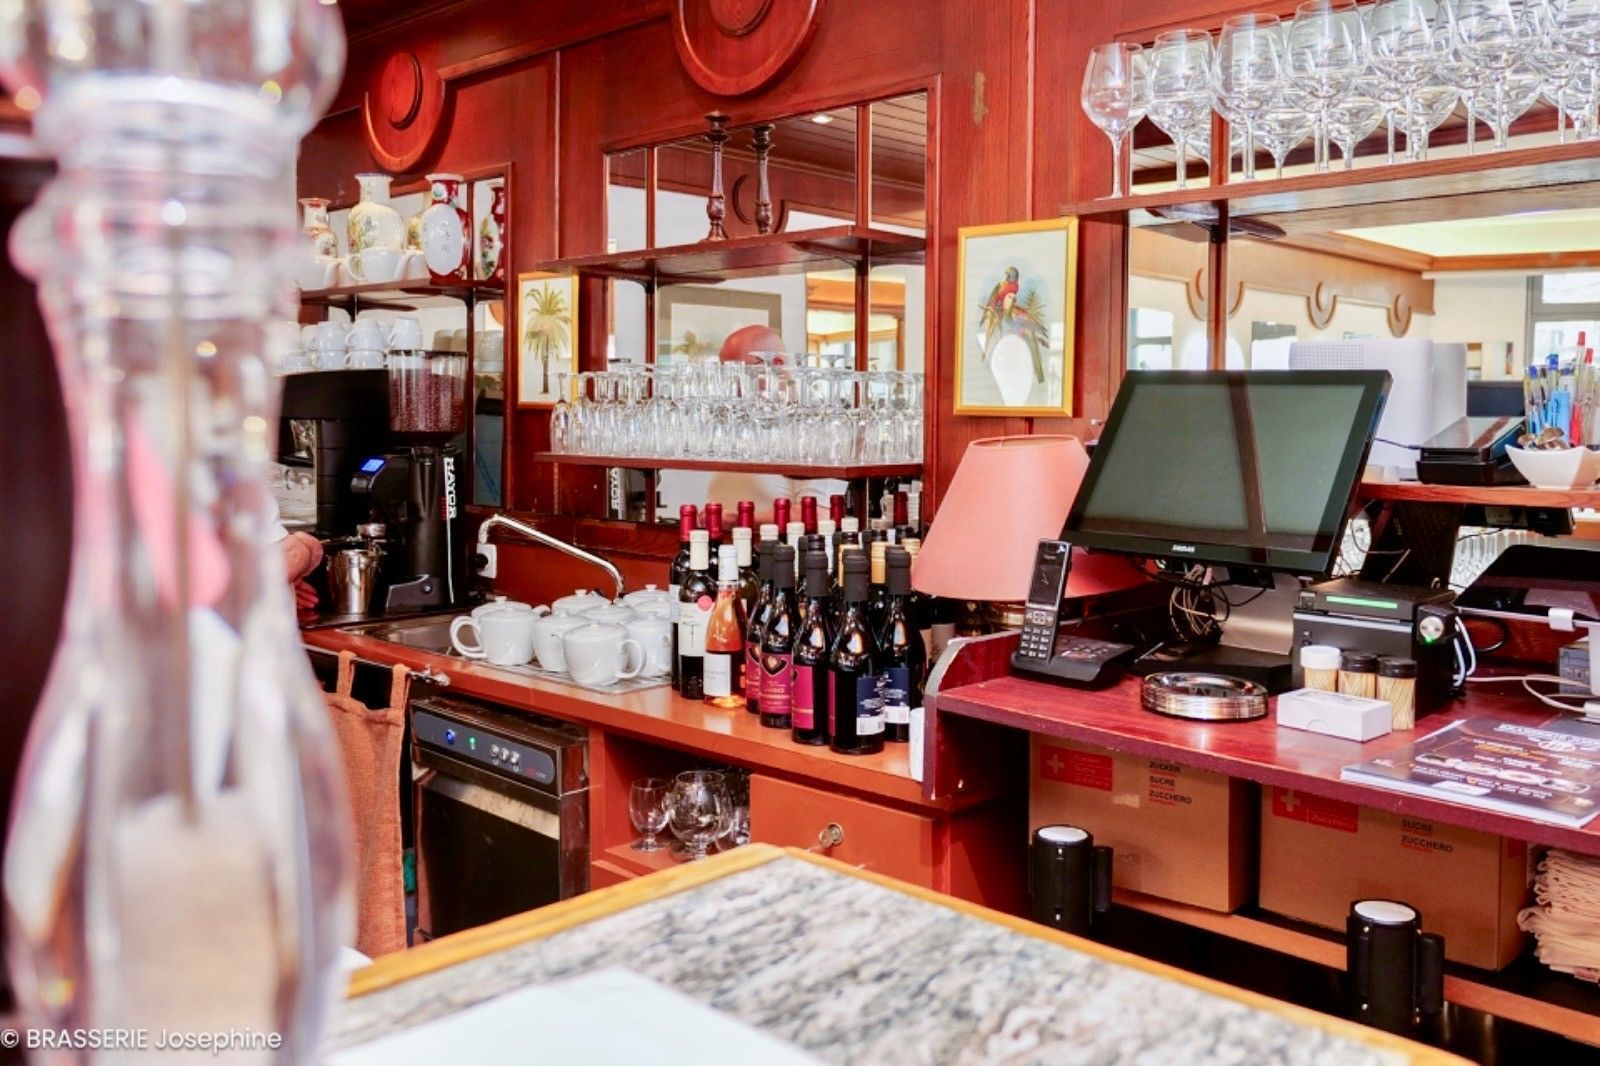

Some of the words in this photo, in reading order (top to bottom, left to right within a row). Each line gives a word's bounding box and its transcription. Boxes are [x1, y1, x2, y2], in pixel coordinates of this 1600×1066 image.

[1149, 761, 1182, 773] ZUCKER
[1149, 790, 1192, 804] ZUCCHERO
[1401, 819, 1433, 832] SUCRE
[1401, 835, 1453, 853] ZUCCHERO
